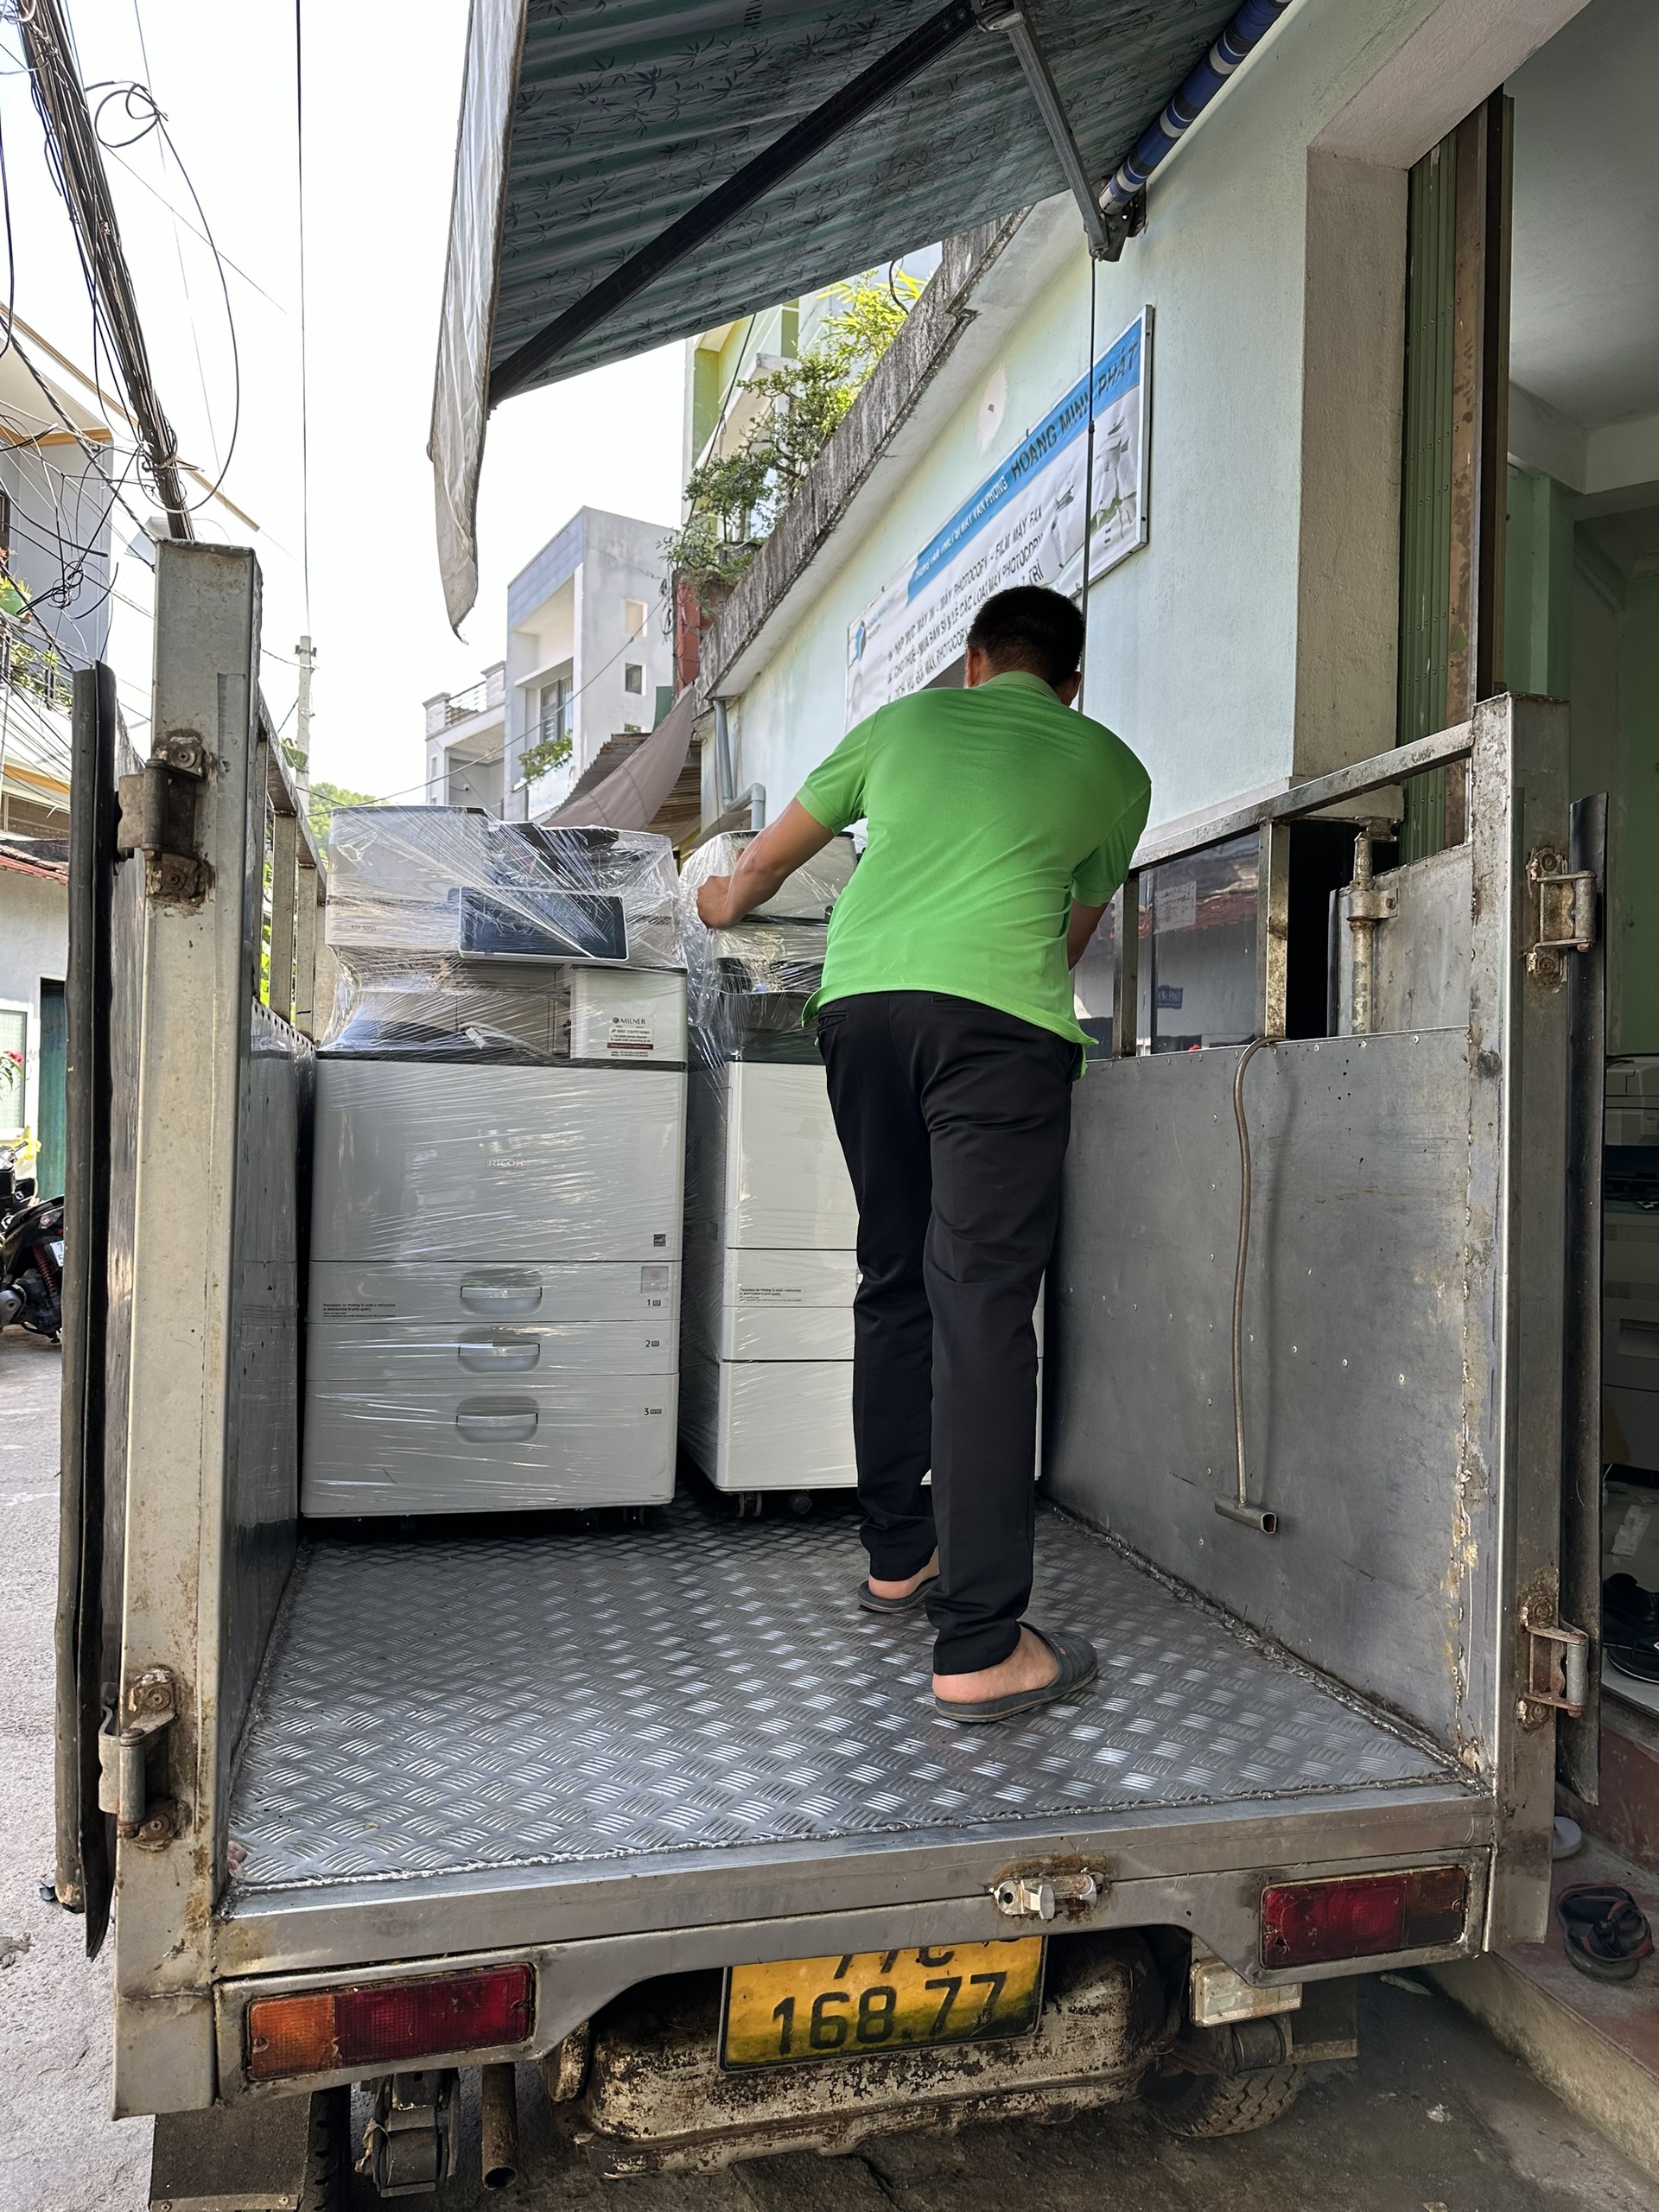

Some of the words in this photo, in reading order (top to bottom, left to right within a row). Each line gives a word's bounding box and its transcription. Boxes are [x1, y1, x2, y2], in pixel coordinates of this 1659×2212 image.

[1097, 340, 1138, 397] PHÁT
[953, 554, 989, 598] PHOTOCOPY
[1013, 518, 1027, 543] MÁY
[1029, 504, 1043, 529] FAX
[1002, 532, 1044, 577] PHOTOCOPY
[645, 1339, 651, 1348] 2
[644, 1408, 650, 1416] 3
[772, 1971, 1008, 2056] 168.77
